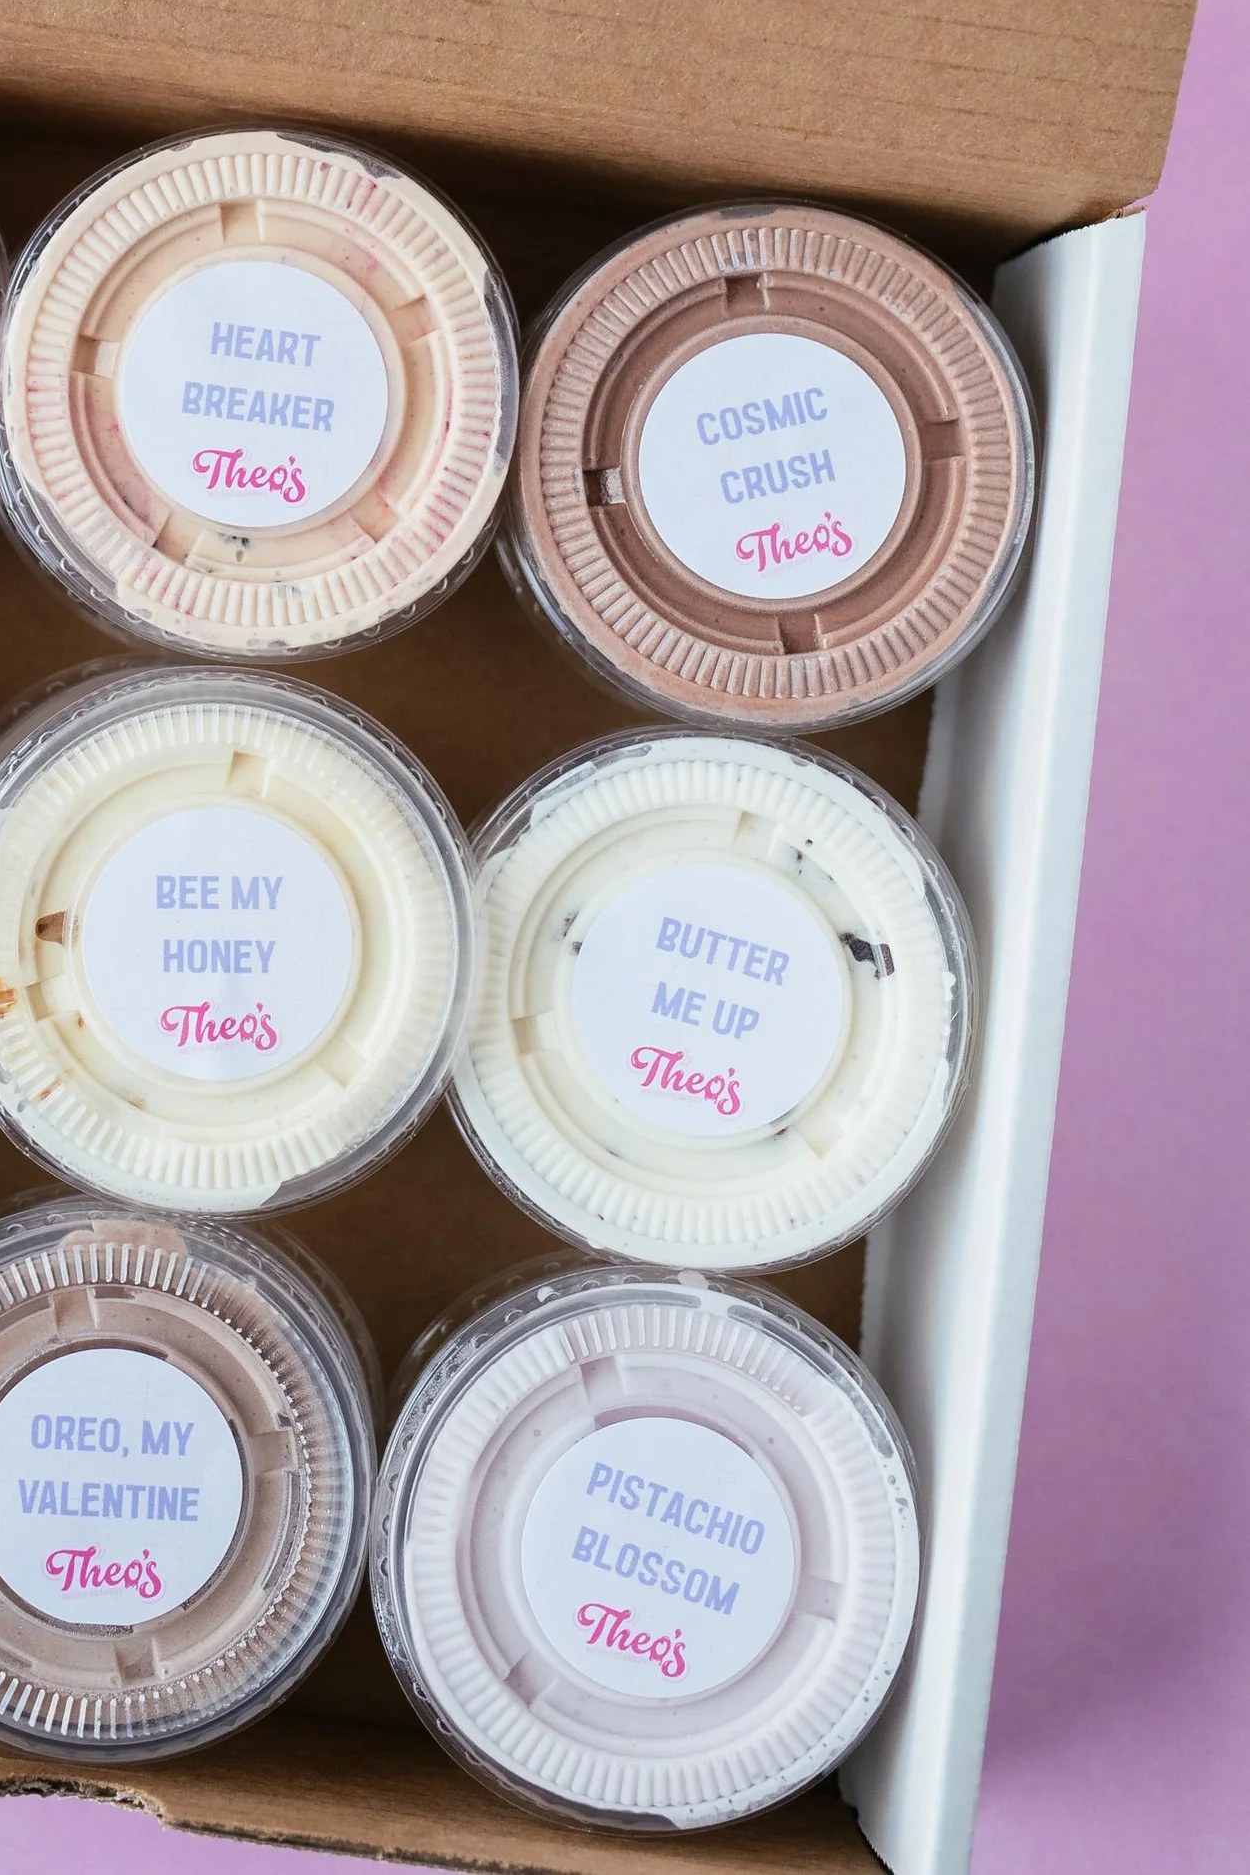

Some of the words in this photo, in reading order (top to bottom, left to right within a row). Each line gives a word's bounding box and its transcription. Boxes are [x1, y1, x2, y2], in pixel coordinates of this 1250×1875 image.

[210, 323, 320, 366] HEART
[182, 381, 334, 432] BREAKER
[696, 387, 828, 446] COSMIC
[192, 444, 306, 504] Theo's
[720, 450, 835, 505] CRUSH
[735, 511, 852, 575] Theo's
[156, 875, 219, 910] BEE
[232, 877, 282, 910] MY
[162, 937, 273, 974] HONEY
[657, 916, 789, 984] BUTTER
[160, 1001, 277, 1051] Theo's
[652, 982, 707, 1027] ME
[714, 996, 760, 1038] UP
[631, 1046, 741, 1115] Theo's
[29, 1413, 132, 1459] OREO,
[139, 1419, 194, 1459] MY
[18, 1477, 203, 1524] VALENTINE
[586, 1461, 765, 1556] PISTACHIO
[45, 1546, 162, 1598] Theo's
[571, 1527, 742, 1615] BLOSSOM
[577, 1603, 685, 1677] Theo's
